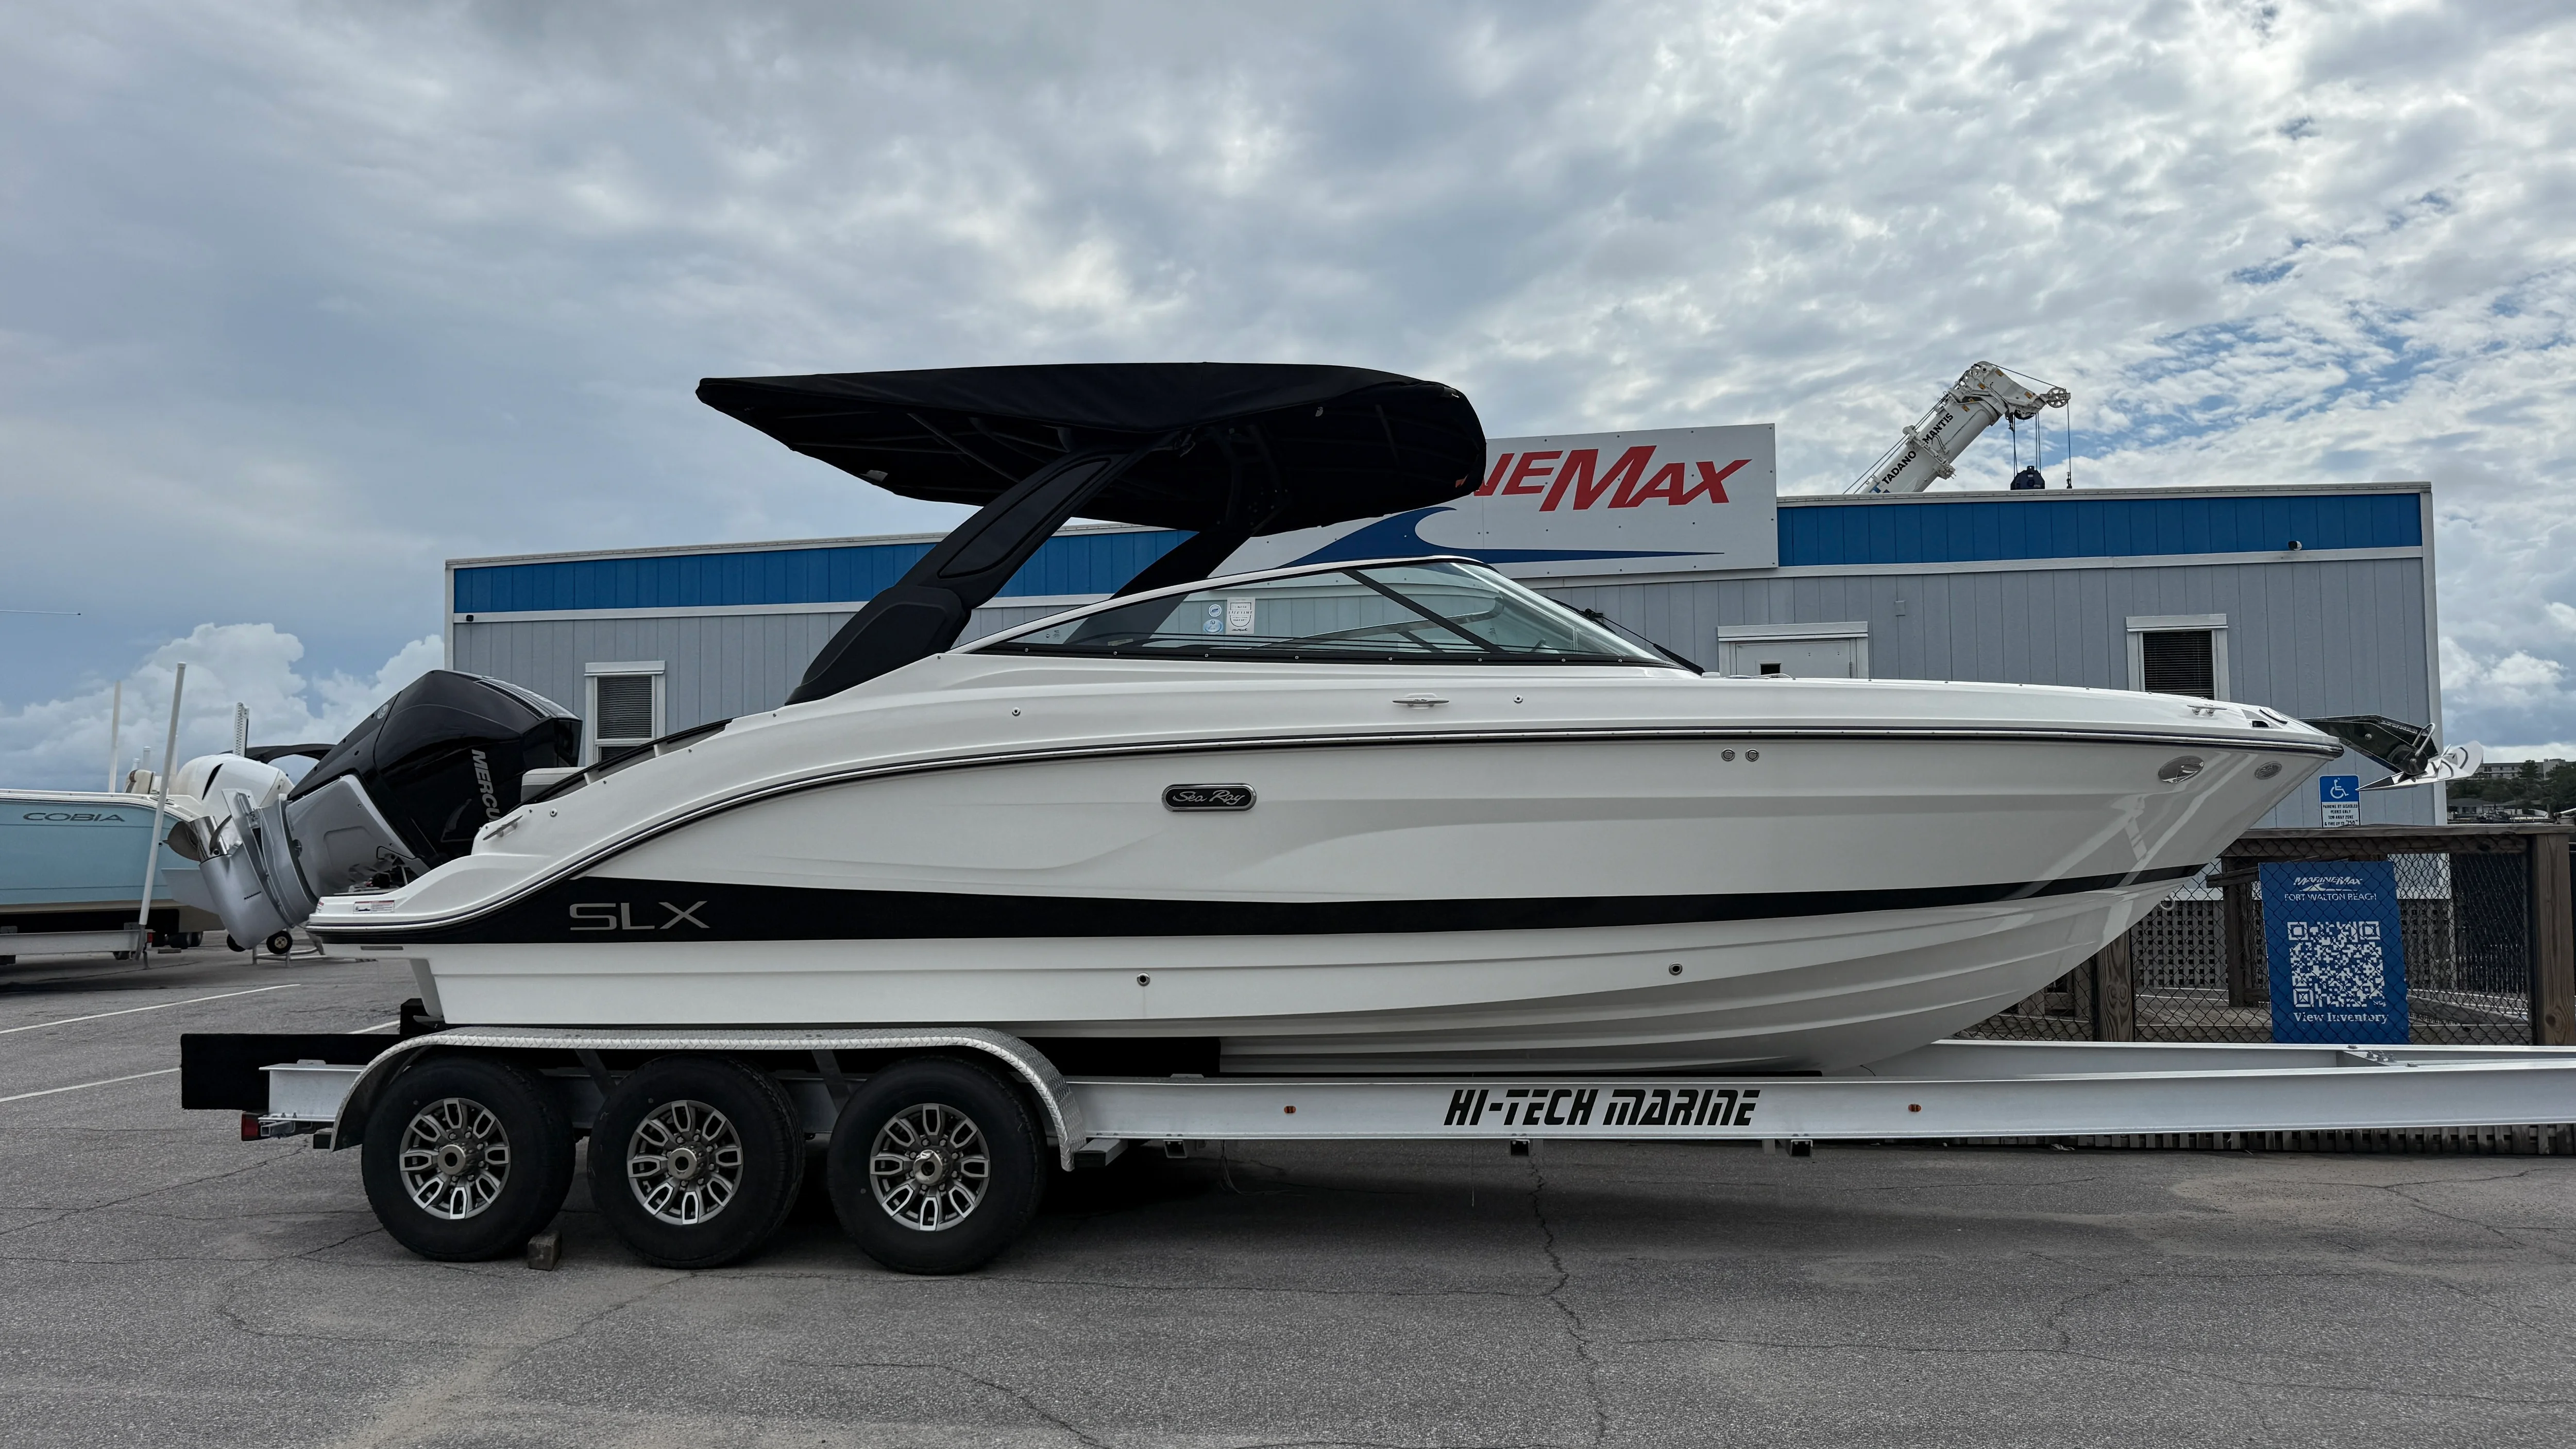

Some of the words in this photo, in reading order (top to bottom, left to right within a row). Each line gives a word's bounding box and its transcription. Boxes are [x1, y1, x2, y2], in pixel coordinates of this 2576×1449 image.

[1882, 451, 1917, 485] TADANO
[1922, 413, 1954, 445] MANTIS
[471, 749, 501, 822] MERCU
[1172, 791, 1208, 803] Sea
[1209, 790, 1245, 805] Ray
[23, 812, 125, 822] COBIA
[569, 900, 710, 930] SLX
[2293, 1012, 2324, 1022] View
[2327, 1012, 2388, 1025] Inventory
[1443, 1089, 1599, 1126] HI-TECH
[1602, 1089, 1761, 1127] MARINE
